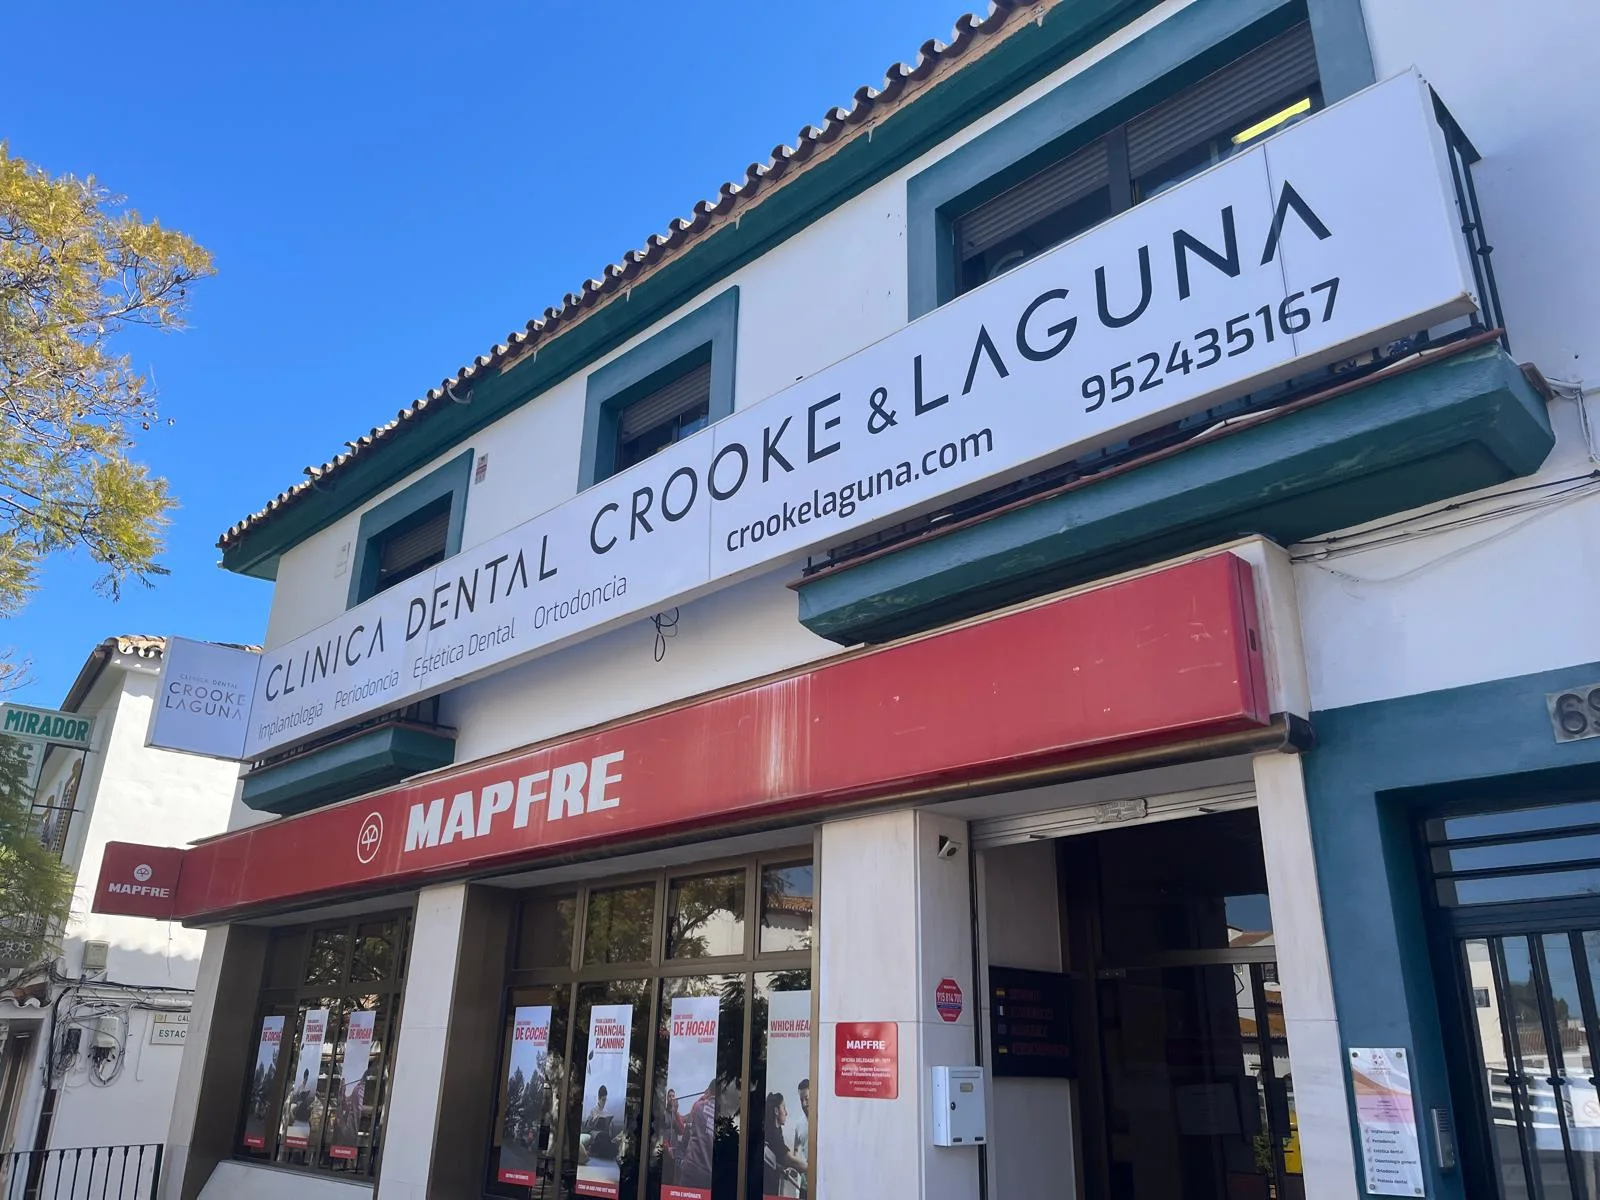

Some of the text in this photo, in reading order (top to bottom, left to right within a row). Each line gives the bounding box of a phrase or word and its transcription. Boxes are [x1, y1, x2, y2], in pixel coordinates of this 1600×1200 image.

[1081, 277, 1341, 413] 952435167
[265, 179, 1332, 702] CLINICA DENTAL CROOKE & LAGUNA
[726, 427, 994, 552] crookelaguna.com
[334, 668, 399, 710] Periodoncia
[412, 641, 464, 680] Estética
[468, 617, 516, 657] Dental
[533, 574, 628, 630] Ortodoncia
[169, 681, 247, 706] CROOKE
[213, 679, 238, 689] DENTAL
[165, 695, 242, 720] LAGUNA
[4, 709, 89, 741] MIRADOR
[404, 750, 625, 853] MAPFRE
[108, 882, 170, 898] MAPFRE
[515, 1026, 548, 1040] DE COCHE
[594, 1025, 625, 1036] FINANCIAL
[673, 1020, 716, 1036] DE HOGAR
[770, 1020, 795, 1031] WHICH
[595, 1038, 624, 1049] PLANNING
[846, 1040, 886, 1050] MAPFRE
